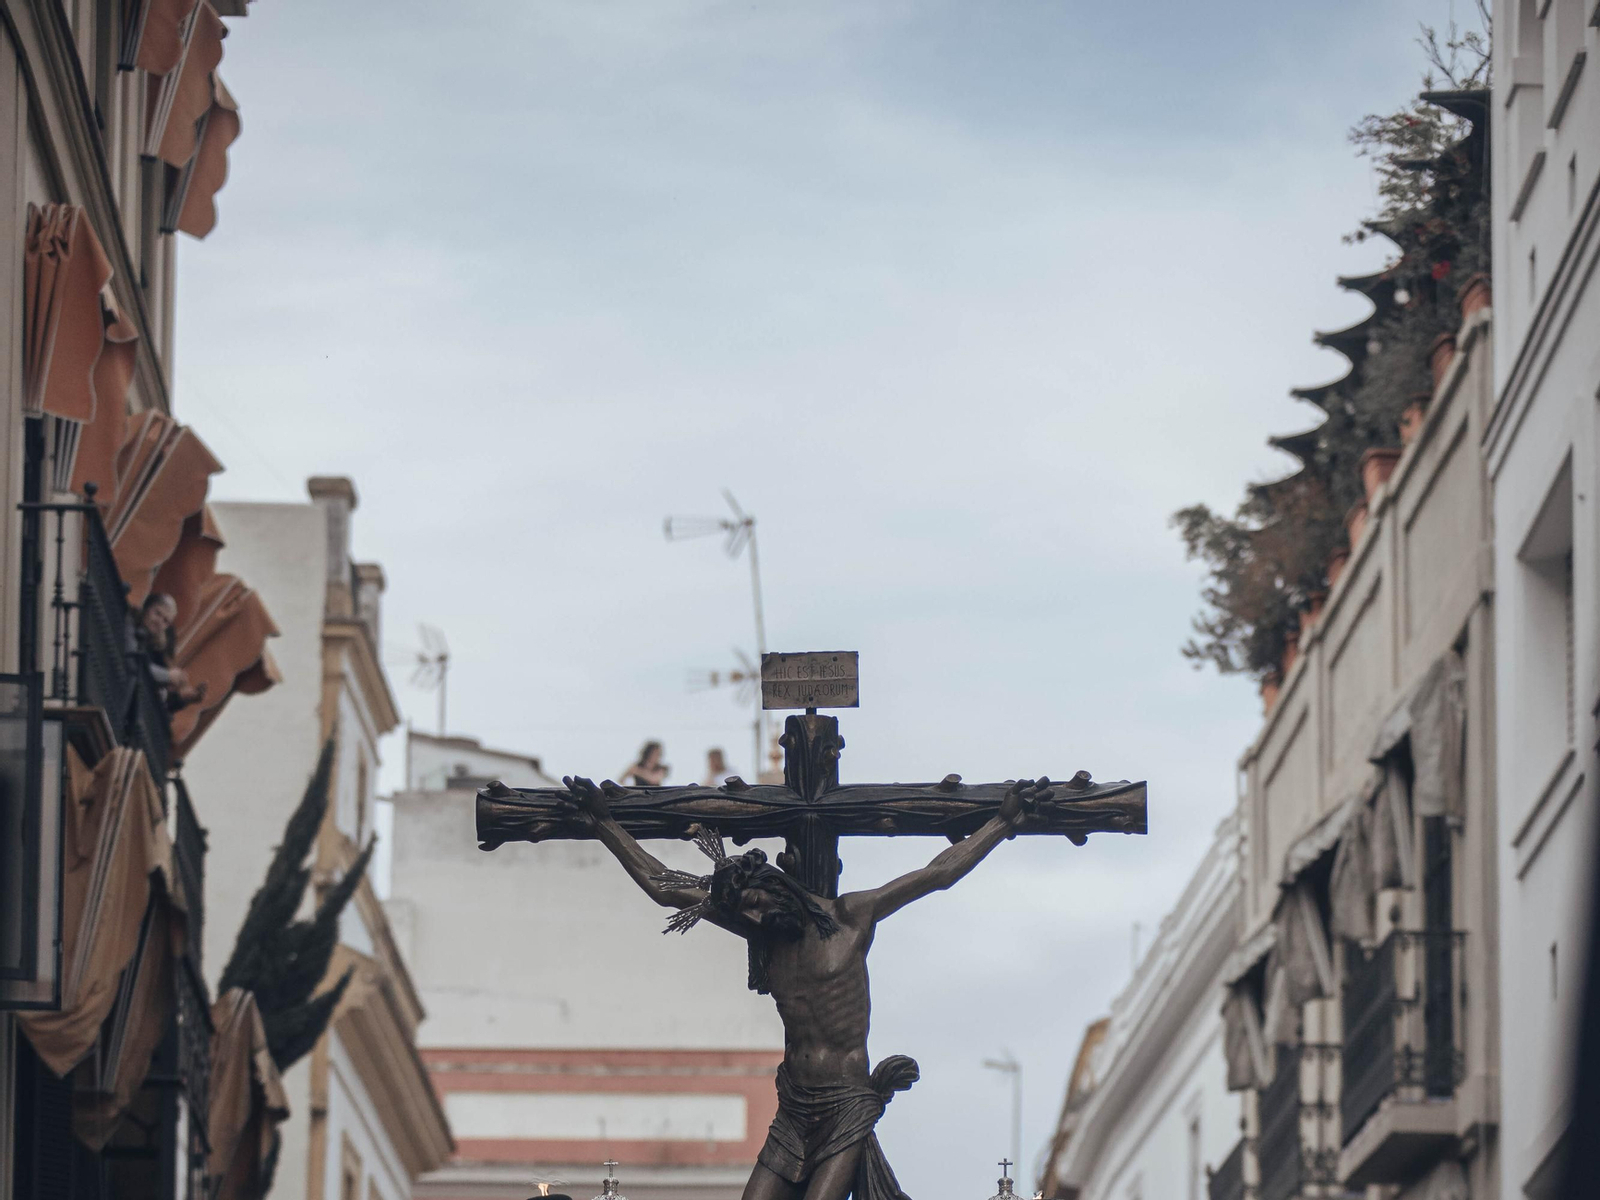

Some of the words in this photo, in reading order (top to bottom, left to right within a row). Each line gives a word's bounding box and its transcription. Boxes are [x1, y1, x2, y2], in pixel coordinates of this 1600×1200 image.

[775, 666, 792, 679] HIC
[797, 665, 815, 678] EST
[819, 664, 846, 678] IESUS
[772, 684, 791, 698] REX
